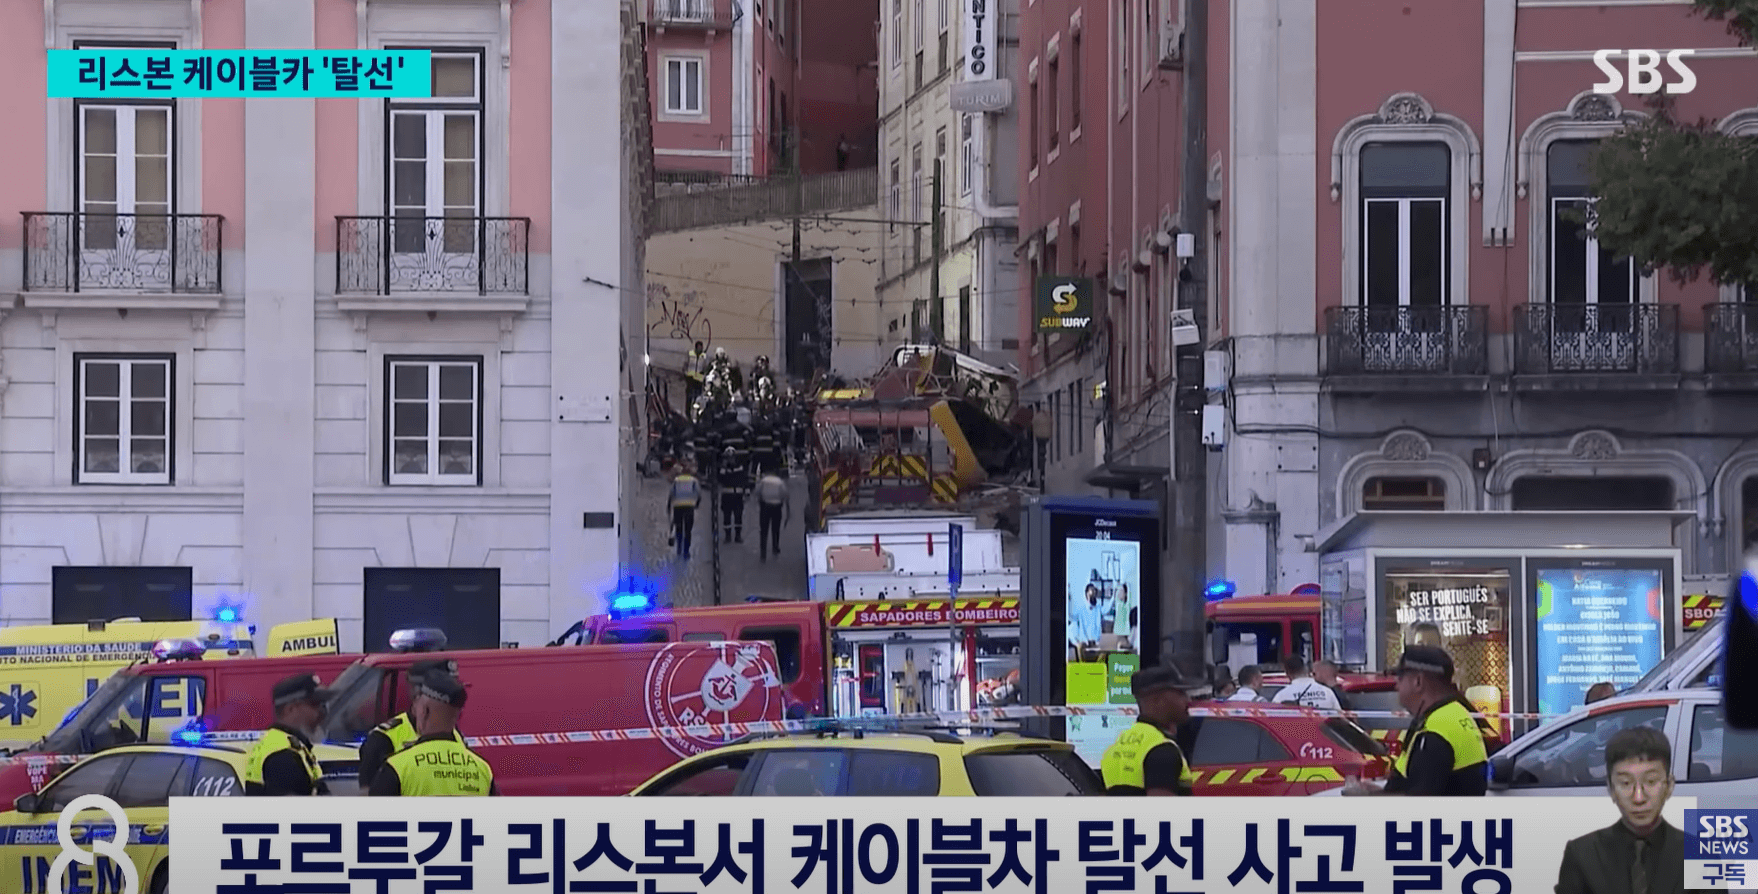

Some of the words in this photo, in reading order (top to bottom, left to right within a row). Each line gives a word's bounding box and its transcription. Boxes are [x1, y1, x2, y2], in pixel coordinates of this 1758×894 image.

[1040, 317, 1091, 328] SUBWAY
[1410, 590, 1429, 607] SER
[1431, 585, 1488, 606] PORTUGUÊS
[860, 611, 941, 622] SAPADORES
[1396, 605, 1416, 624] NÃO
[1419, 608, 1431, 622] SE
[1433, 605, 1475, 621] EXPLICA,
[1443, 619, 1489, 637] SENTE-SE
[85, 644, 101, 653] DA
[20, 655, 72, 664] NACIONAL
[76, 653, 90, 662] DE
[1309, 746, 1333, 759] 112
[434, 769, 480, 781] municipal
[203, 777, 236, 796] 112
